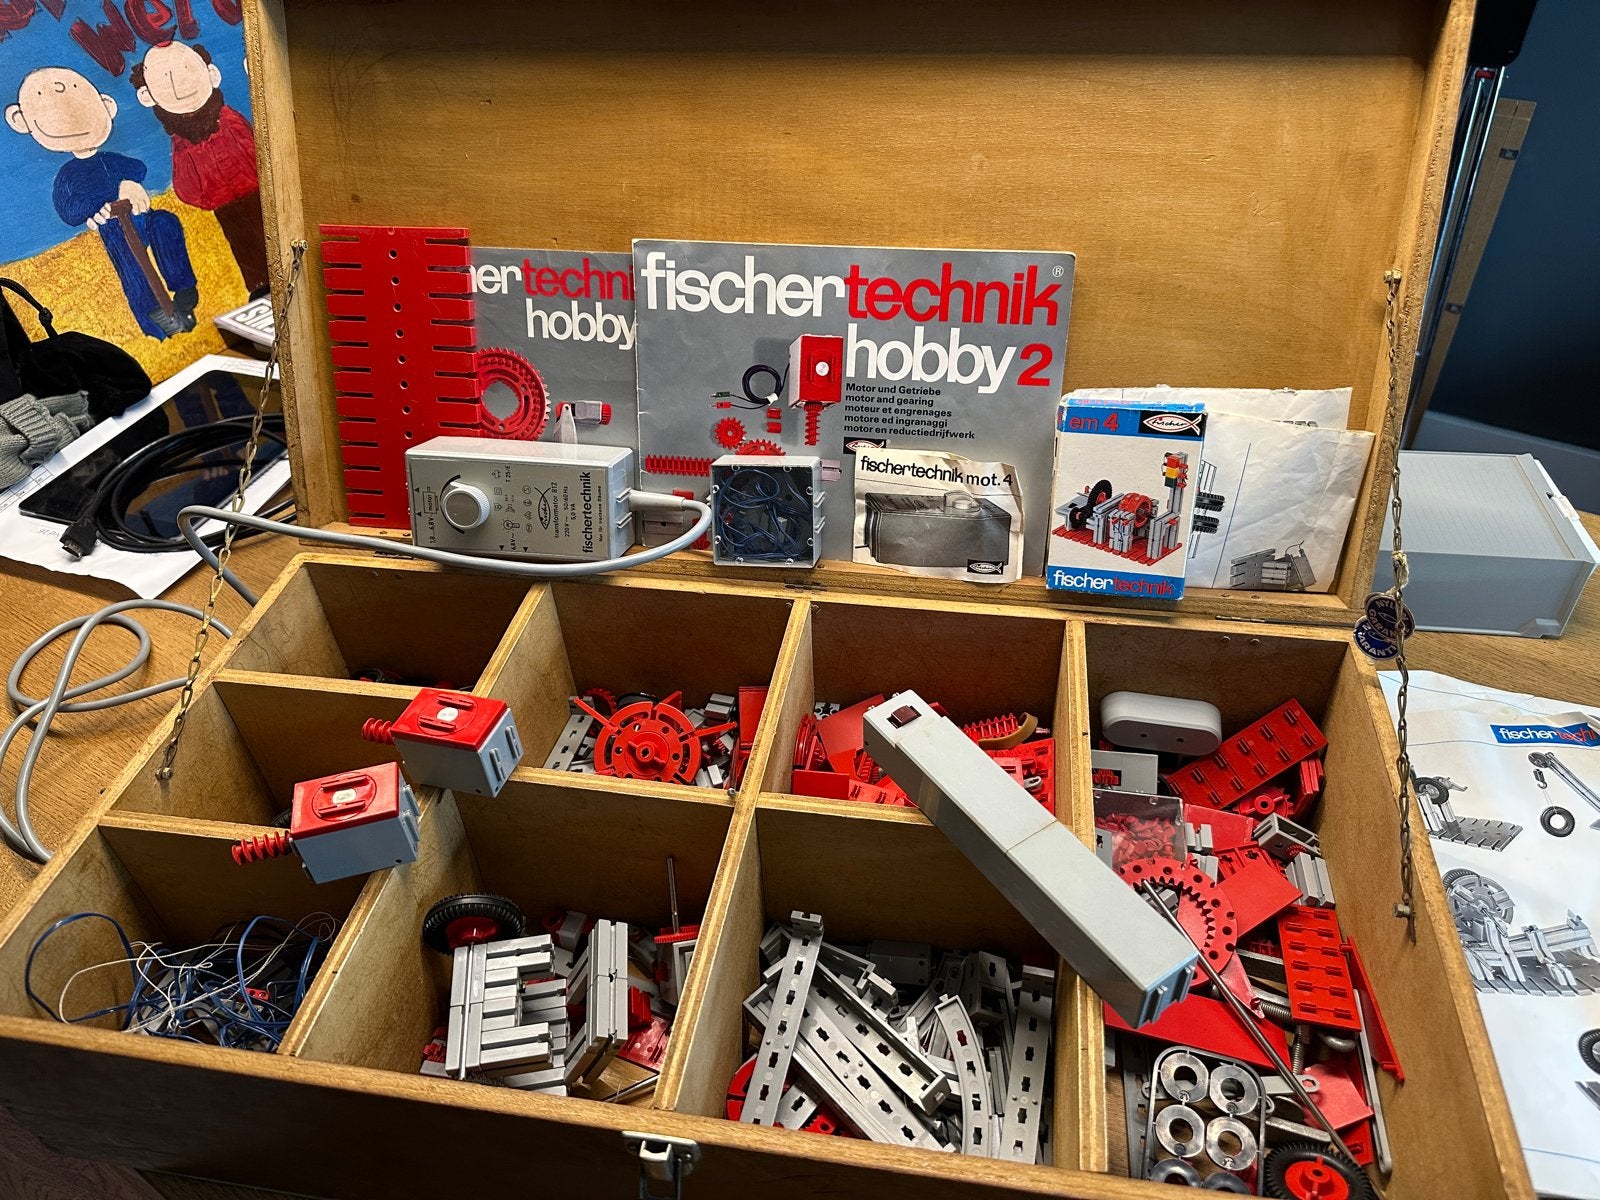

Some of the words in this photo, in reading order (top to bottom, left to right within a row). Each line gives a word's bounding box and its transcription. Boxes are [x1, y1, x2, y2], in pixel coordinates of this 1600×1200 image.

[640, 251, 1063, 326] fischertechnik
[525, 297, 636, 351] hobby
[845, 322, 1018, 394] hobby
[1016, 342, 1054, 387] 2
[845, 382, 876, 393] Motor
[877, 383, 897, 394] und
[898, 385, 942, 396] Getriebe
[845, 394, 875, 403] motor
[876, 395, 895, 404] and
[896, 396, 935, 408] gearing
[844, 405, 880, 414] moteur
[881, 406, 893, 414] et
[893, 407, 953, 418] engrenages
[844, 414, 880, 424] motore
[881, 416, 894, 424] ed
[895, 417, 949, 429] ingranaggi
[1069, 416, 1099, 430] em
[1102, 412, 1120, 432] 4
[843, 425, 873, 434] motor
[874, 426, 887, 434] en
[888, 427, 976, 440] reductiedrijfwerk
[860, 455, 964, 484] fischertechnik
[965, 473, 1002, 487] mot.
[1002, 473, 1014, 487] 4
[550, 481, 558, 494] 812
[552, 495, 560, 539] transformator
[580, 471, 594, 554] fischertechnik
[1052, 569, 1174, 597] fischertechnik
